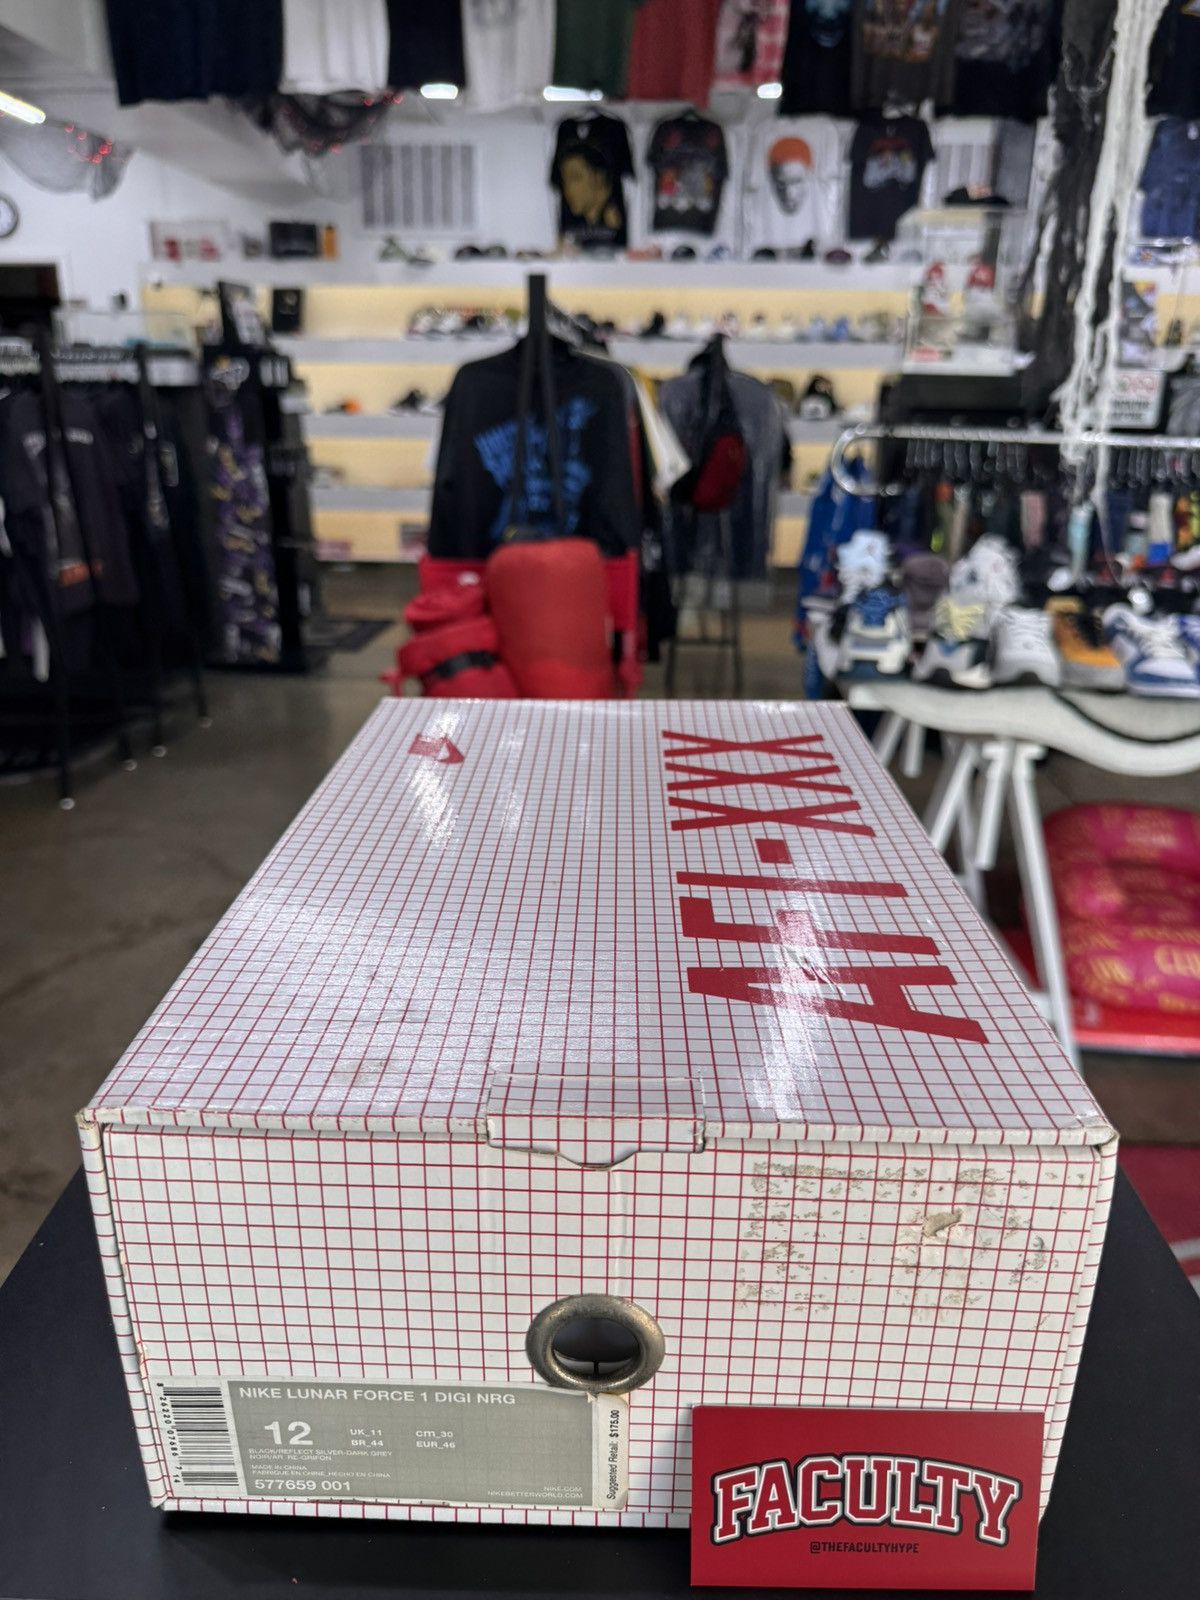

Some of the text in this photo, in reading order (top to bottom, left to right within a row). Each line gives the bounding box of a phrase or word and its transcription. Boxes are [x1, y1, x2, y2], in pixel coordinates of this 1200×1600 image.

[239, 1387, 516, 1405] NIKE LUNAR FORCE 1 DIGI NRG
[263, 1420, 314, 1446] 12
[606, 1409, 620, 1500] Suggested Retail: $175.00
[255, 1479, 351, 1491] 577659 001
[711, 1453, 1024, 1547] FACULTY
[809, 1541, 920, 1555] @THEFACULTYHYPE
